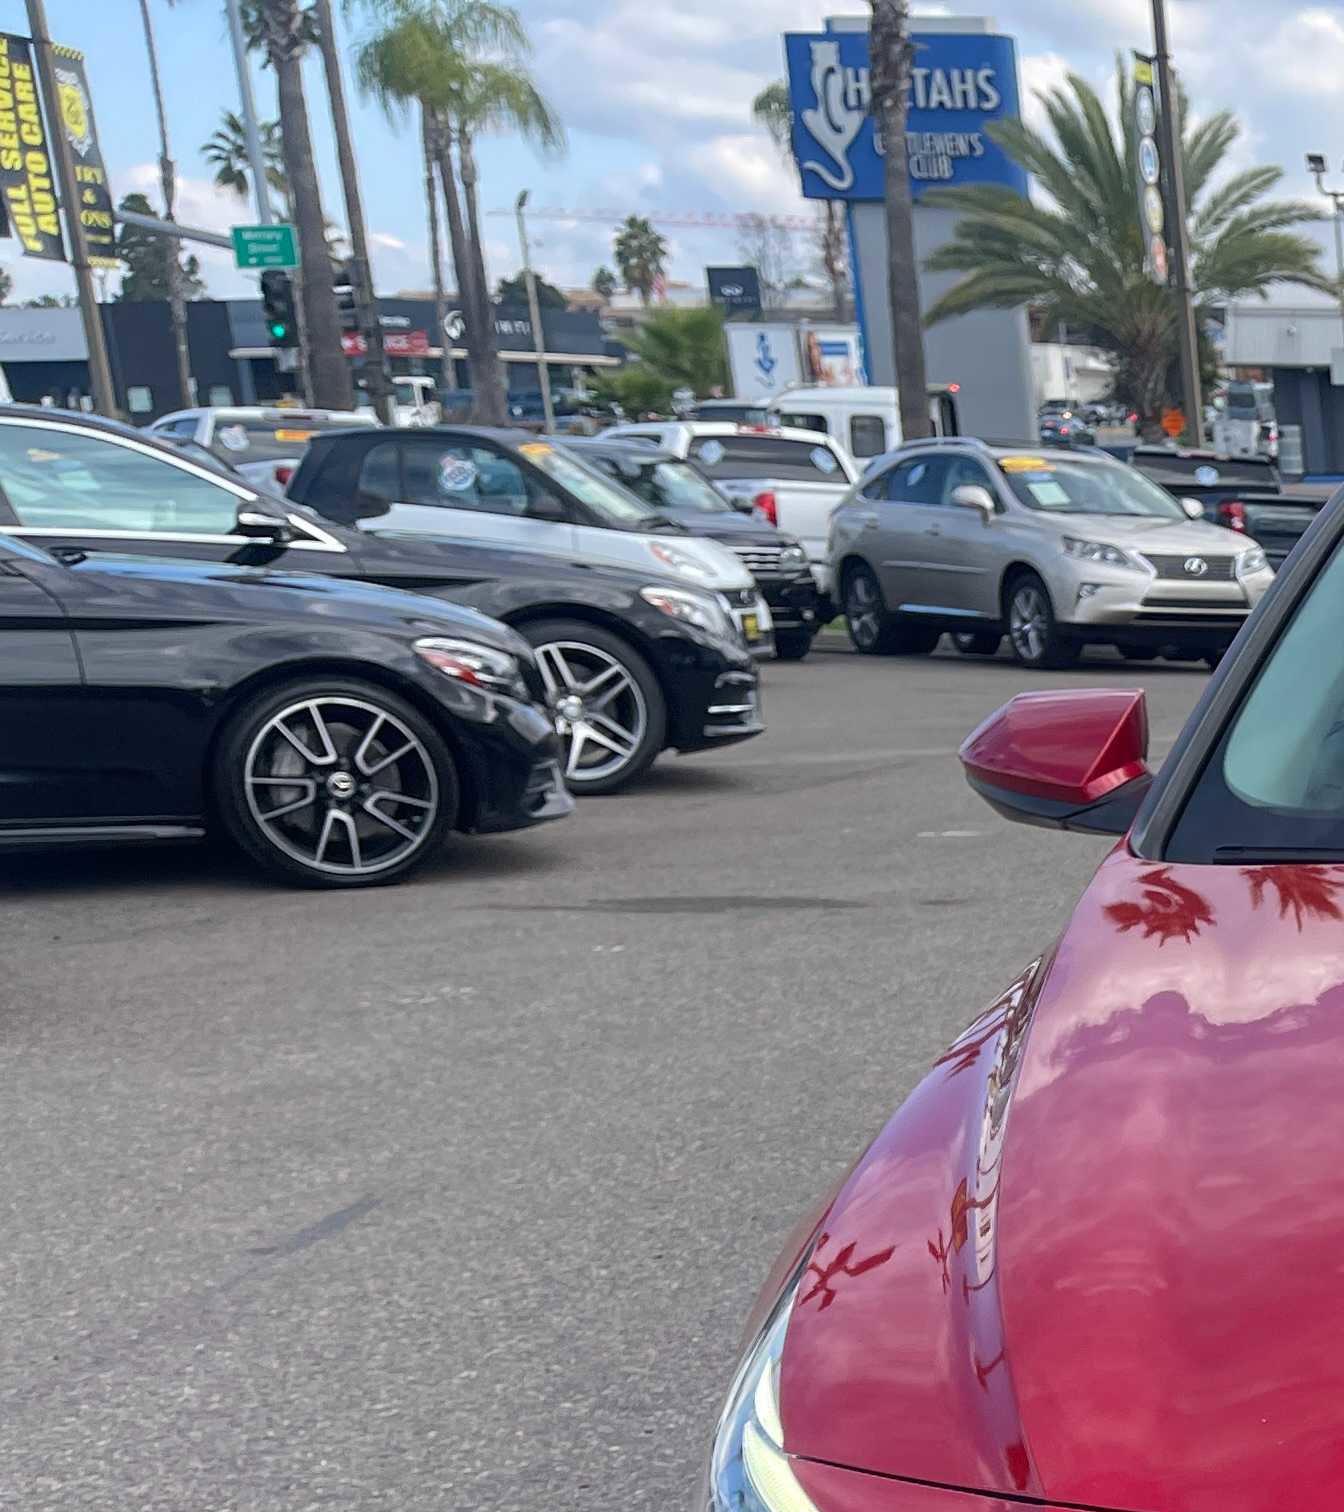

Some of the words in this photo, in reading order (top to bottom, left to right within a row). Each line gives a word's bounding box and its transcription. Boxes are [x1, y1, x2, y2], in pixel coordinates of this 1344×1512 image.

[12, 63, 43, 146] CARE
[25, 151, 60, 236] AUTO
[909, 155, 954, 180] CLUB
[7, 183, 44, 252] FULL
